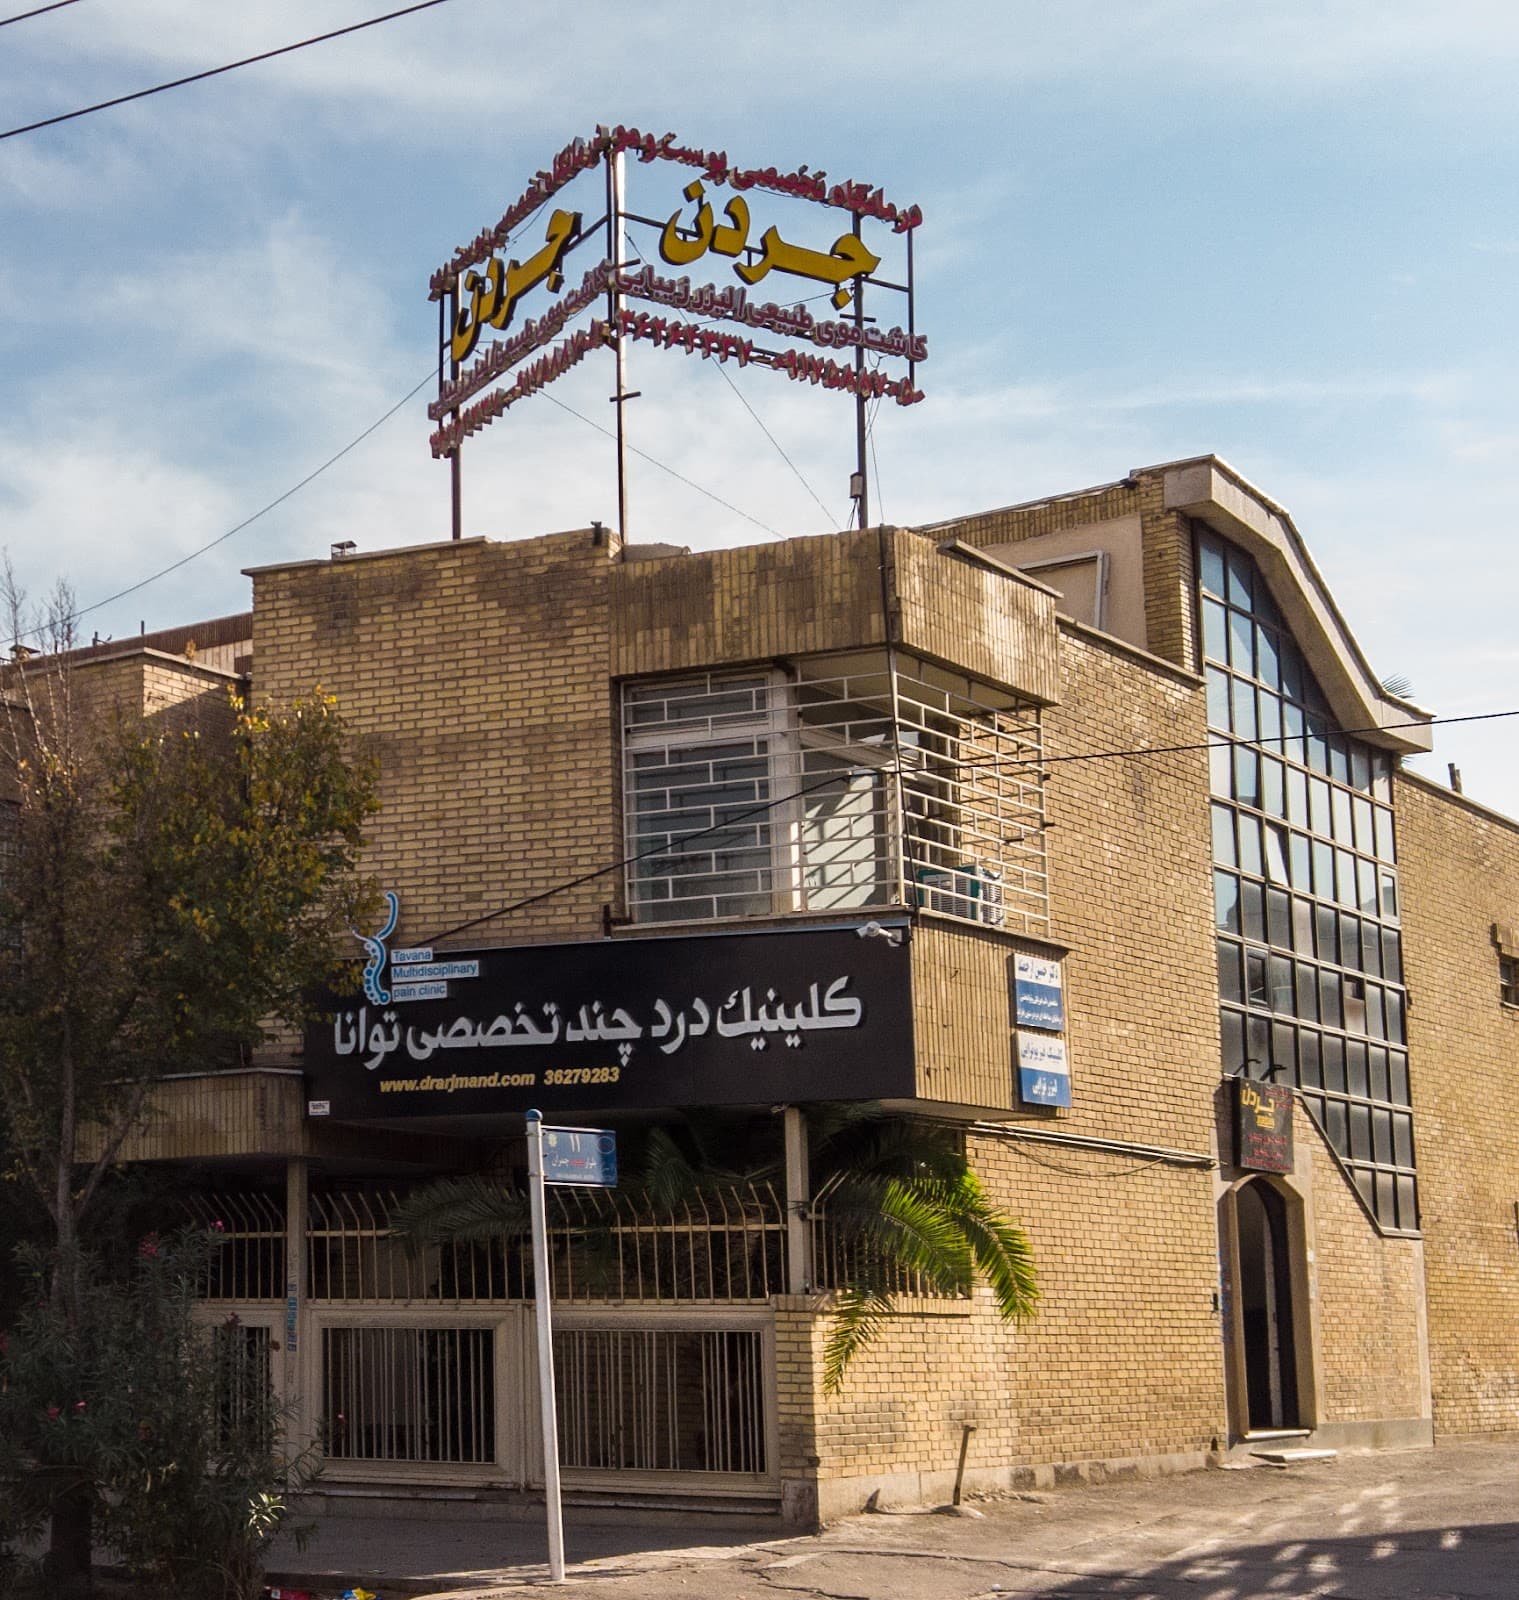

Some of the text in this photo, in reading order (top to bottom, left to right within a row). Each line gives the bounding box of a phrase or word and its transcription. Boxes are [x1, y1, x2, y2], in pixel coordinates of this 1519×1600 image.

[659, 180, 881, 310] جردن
[747, 302, 814, 336] طبیعی
[814, 320, 863, 349] موی
[863, 326, 928, 362] کاشت
[393, 950, 431, 961] Tavana
[393, 963, 477, 979] Multidisciplinary
[393, 984, 446, 998] pain clinic
[334, 1006, 400, 1070] توانا
[406, 1001, 560, 1061] تخصصی
[566, 1000, 643, 1067] چند
[650, 997, 710, 1055] درد
[379, 1066, 620, 1093] www.drarjmand.com 36279283
